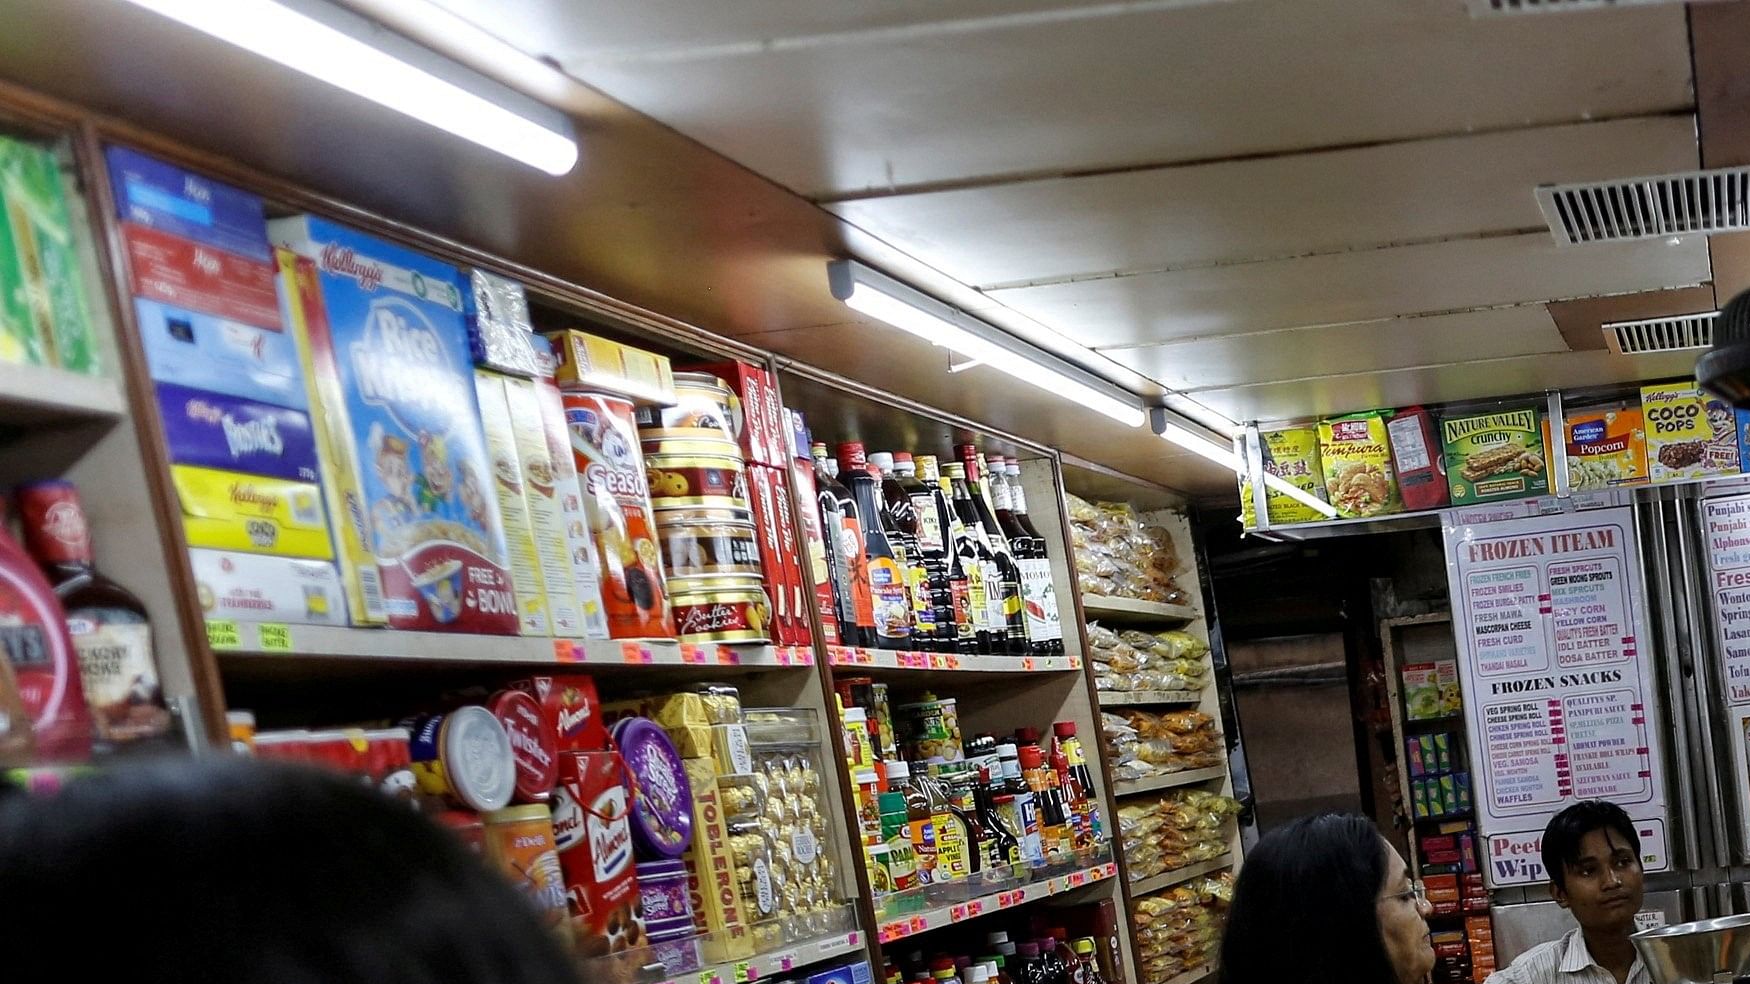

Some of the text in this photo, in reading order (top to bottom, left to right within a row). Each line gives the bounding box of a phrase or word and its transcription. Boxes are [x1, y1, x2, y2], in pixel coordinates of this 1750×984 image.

[1646, 392, 1679, 402] Kellogg's
[1648, 404, 1700, 421] COCO
[1446, 409, 1535, 441] NATURE VALLEY
[1572, 426, 1604, 435] American
[1656, 419, 1695, 433] POPS
[1573, 433, 1600, 441] Garden
[1580, 440, 1624, 454] Popcorn
[1709, 451, 1735, 460] FREE!
[1708, 501, 1745, 517] Punjabi
[1710, 518, 1747, 533] Punjabi
[1469, 529, 1615, 563] FROZEN ITEAM
[468, 567, 496, 585] FREE
[1550, 565, 1571, 575] FRESH
[1550, 576, 1568, 586] GREEN
[686, 603, 733, 624] Butter
[1580, 605, 1606, 614] CORN
[681, 611, 743, 634] Cookies
[1474, 610, 1523, 623] FRESH MAWA
[1556, 616, 1607, 627] YELLOW CORN
[1511, 621, 1532, 630] CHEESE
[1477, 635, 1523, 648] FRESH CURD
[1558, 638, 1610, 652] IDLI BATTER
[1559, 650, 1618, 663] DOSA BATTER
[1728, 663, 1749, 679] Tofu
[1492, 670, 1622, 695] FROZEN SNACKS
[1486, 703, 1539, 715] VEG SPRING ROLL
[557, 699, 591, 737] Almond
[1487, 712, 1542, 724] CHEESE SPRING ROLL
[1509, 722, 1531, 731] SPRING
[1532, 720, 1546, 728] ROLL
[1514, 731, 1533, 739] SPRING
[1535, 729, 1548, 737] ROLL
[1511, 757, 1539, 766] SAMOSA
[1497, 794, 1532, 804] WAFFLES
[594, 826, 628, 865] Almond
[697, 791, 744, 939] TOBLERONE
